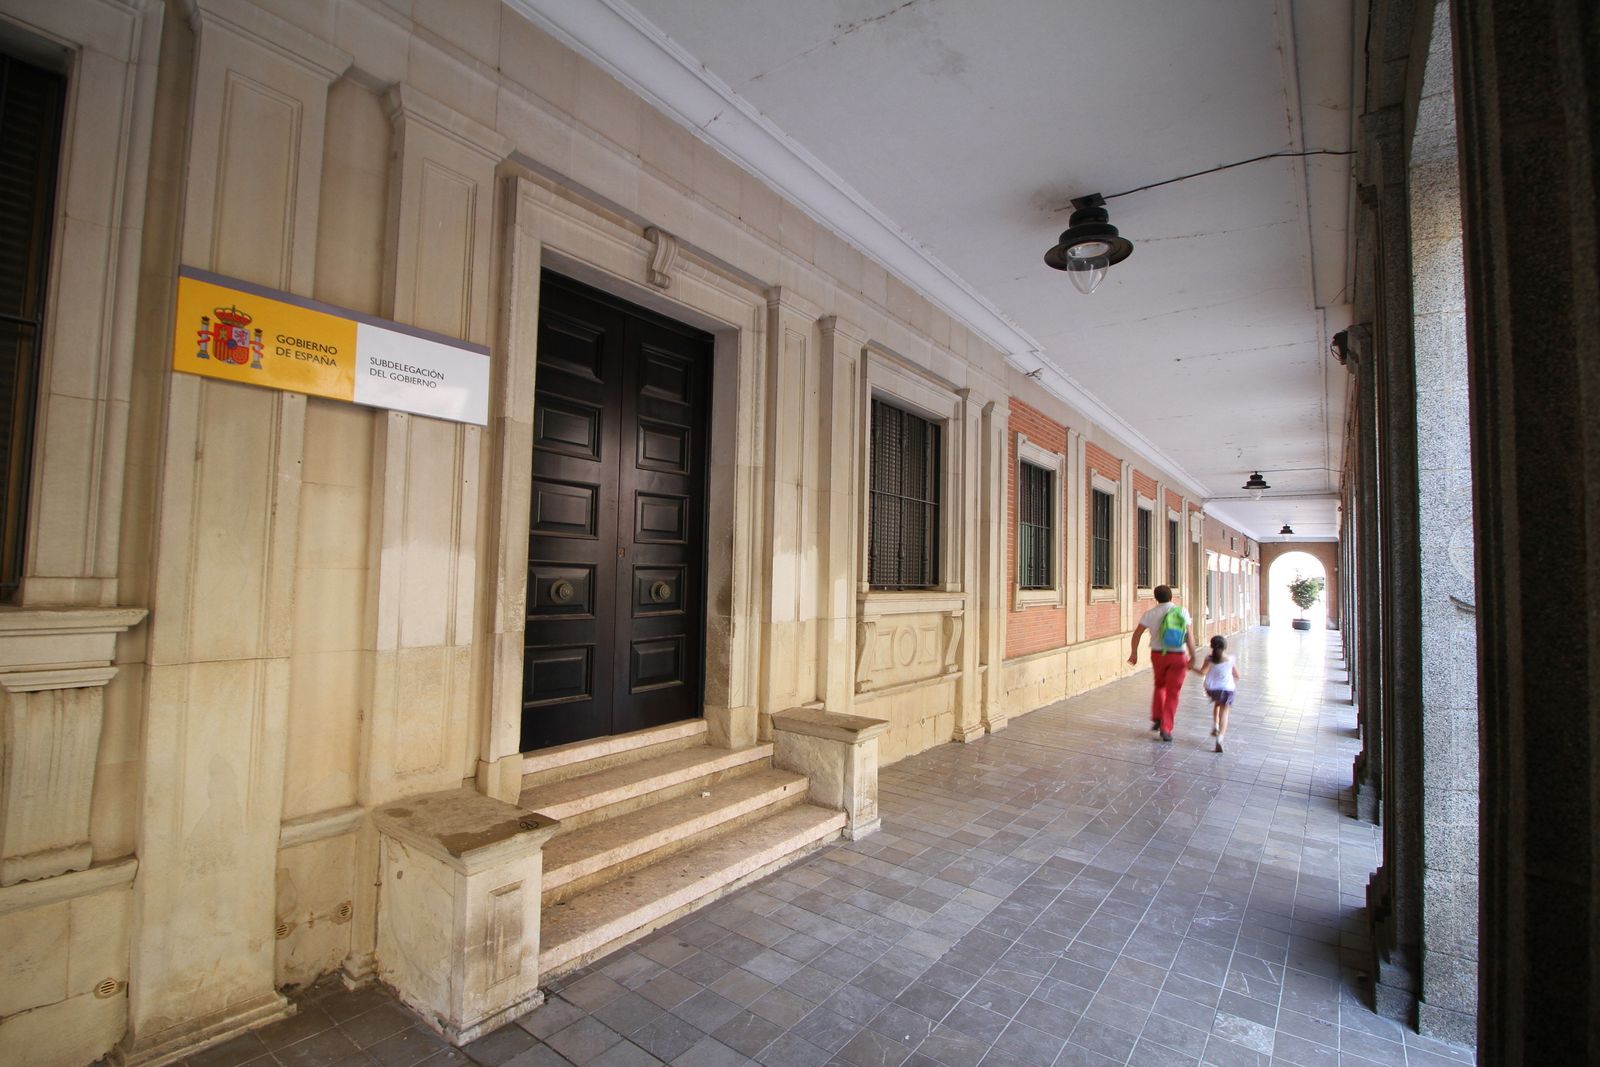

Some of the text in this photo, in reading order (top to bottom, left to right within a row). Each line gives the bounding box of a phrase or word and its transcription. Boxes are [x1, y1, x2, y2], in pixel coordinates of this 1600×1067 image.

[276, 335, 337, 355] GOBIERNO
[276, 347, 337, 367] DE ESPAÑA
[369, 368, 437, 389] DEL GOBIERNO
[370, 357, 444, 380] SUBDELEGACIÓN
